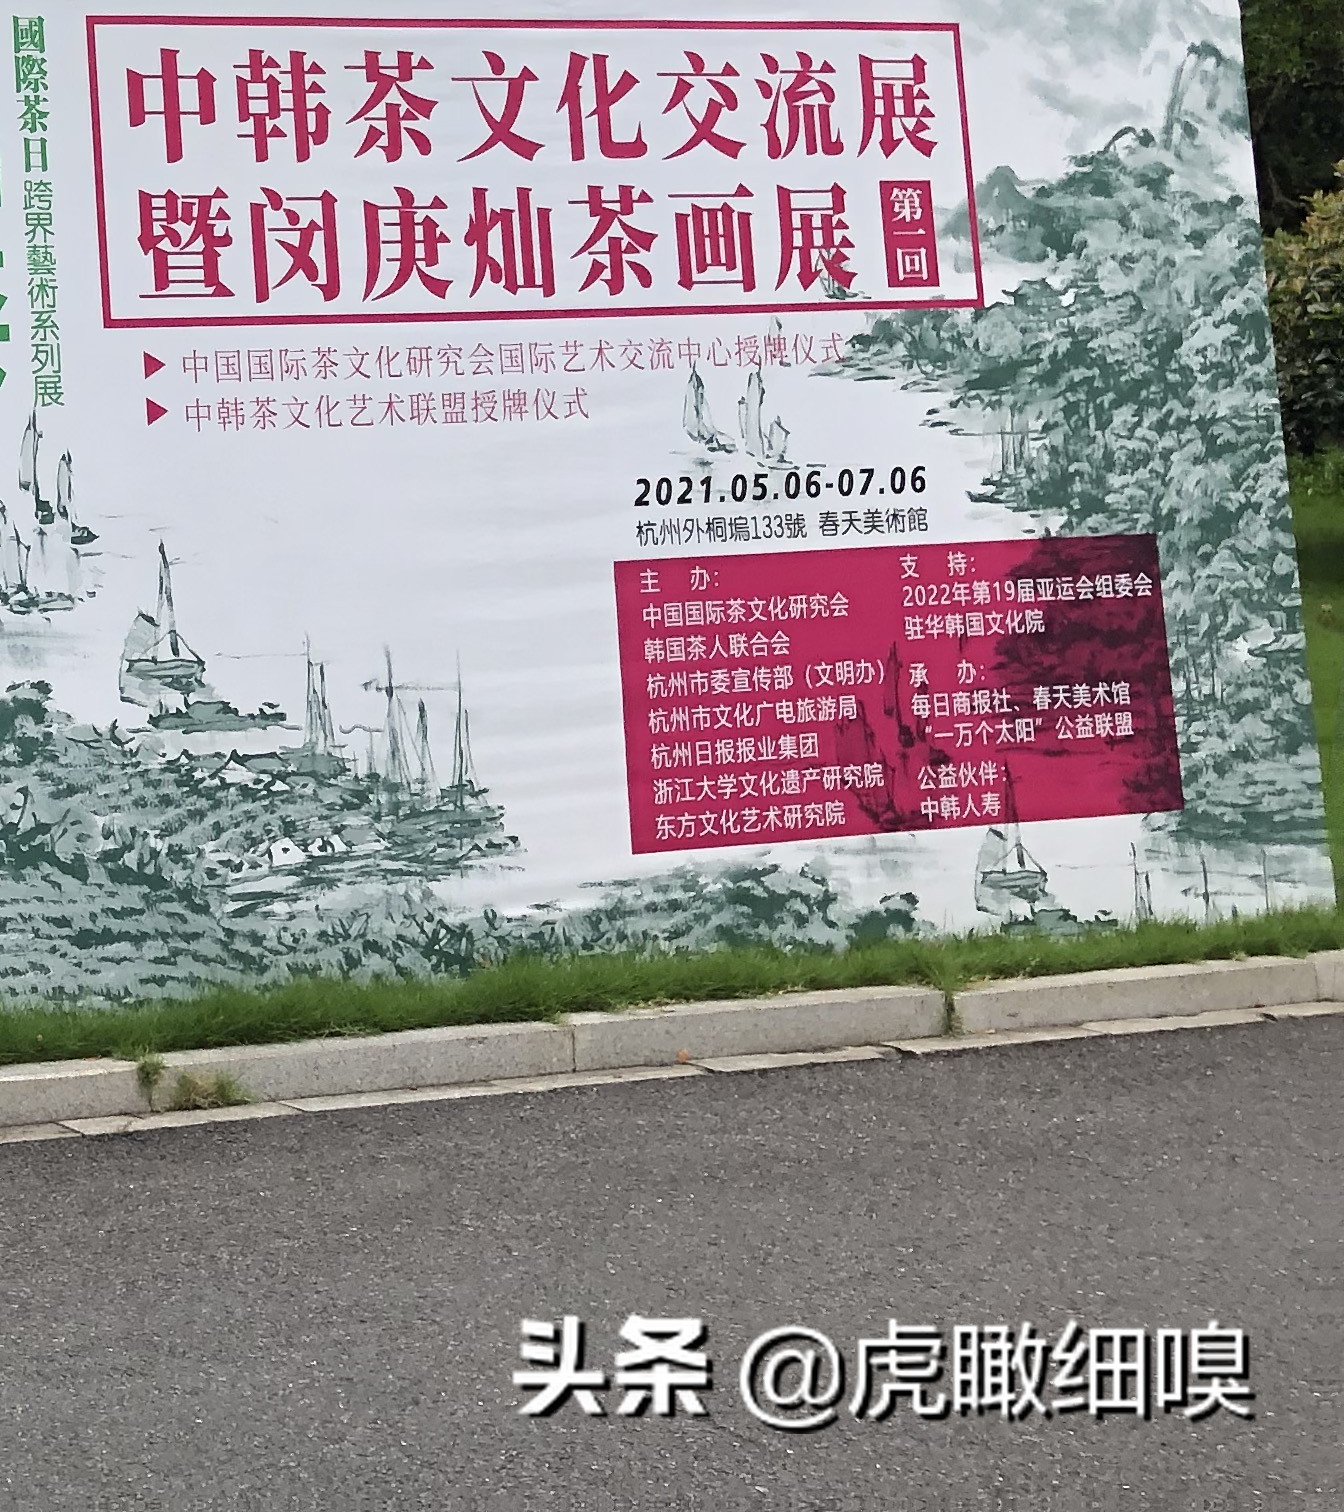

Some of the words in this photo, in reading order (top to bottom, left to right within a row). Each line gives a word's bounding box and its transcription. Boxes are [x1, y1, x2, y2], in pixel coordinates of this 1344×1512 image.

[125, 47, 940, 164] 中韩茶文化交流展
[135, 182, 858, 303] 暨闵庚灿茶画展
[889, 186, 930, 285] 第一回
[180, 333, 846, 384] 中国国际茶文化研究会国际艺术交流中心授牌仪式
[184, 387, 591, 433] 中韩茶文化艺术联盟授牌仪式
[633, 465, 927, 507] 2021.05.06-07.06
[818, 506, 929, 537] 春天美術館
[642, 590, 850, 629] 中国国际茶文化研究会
[902, 571, 1153, 607] 2022年第19届亚运会组委会
[904, 608, 1046, 641] 驻华韩国文化院
[643, 629, 791, 664] 韩国茶人联合会
[648, 694, 859, 735] 杭州市文化广电旅游局
[911, 681, 1132, 719] 每日商报社、春天美术馆
[650, 732, 819, 770] 杭州日报报业集团
[653, 762, 885, 805] 浙江大学文化遗产研究院
[655, 799, 846, 841] 东方文化艺术研究院
[920, 791, 1002, 823] 中韩人寿
